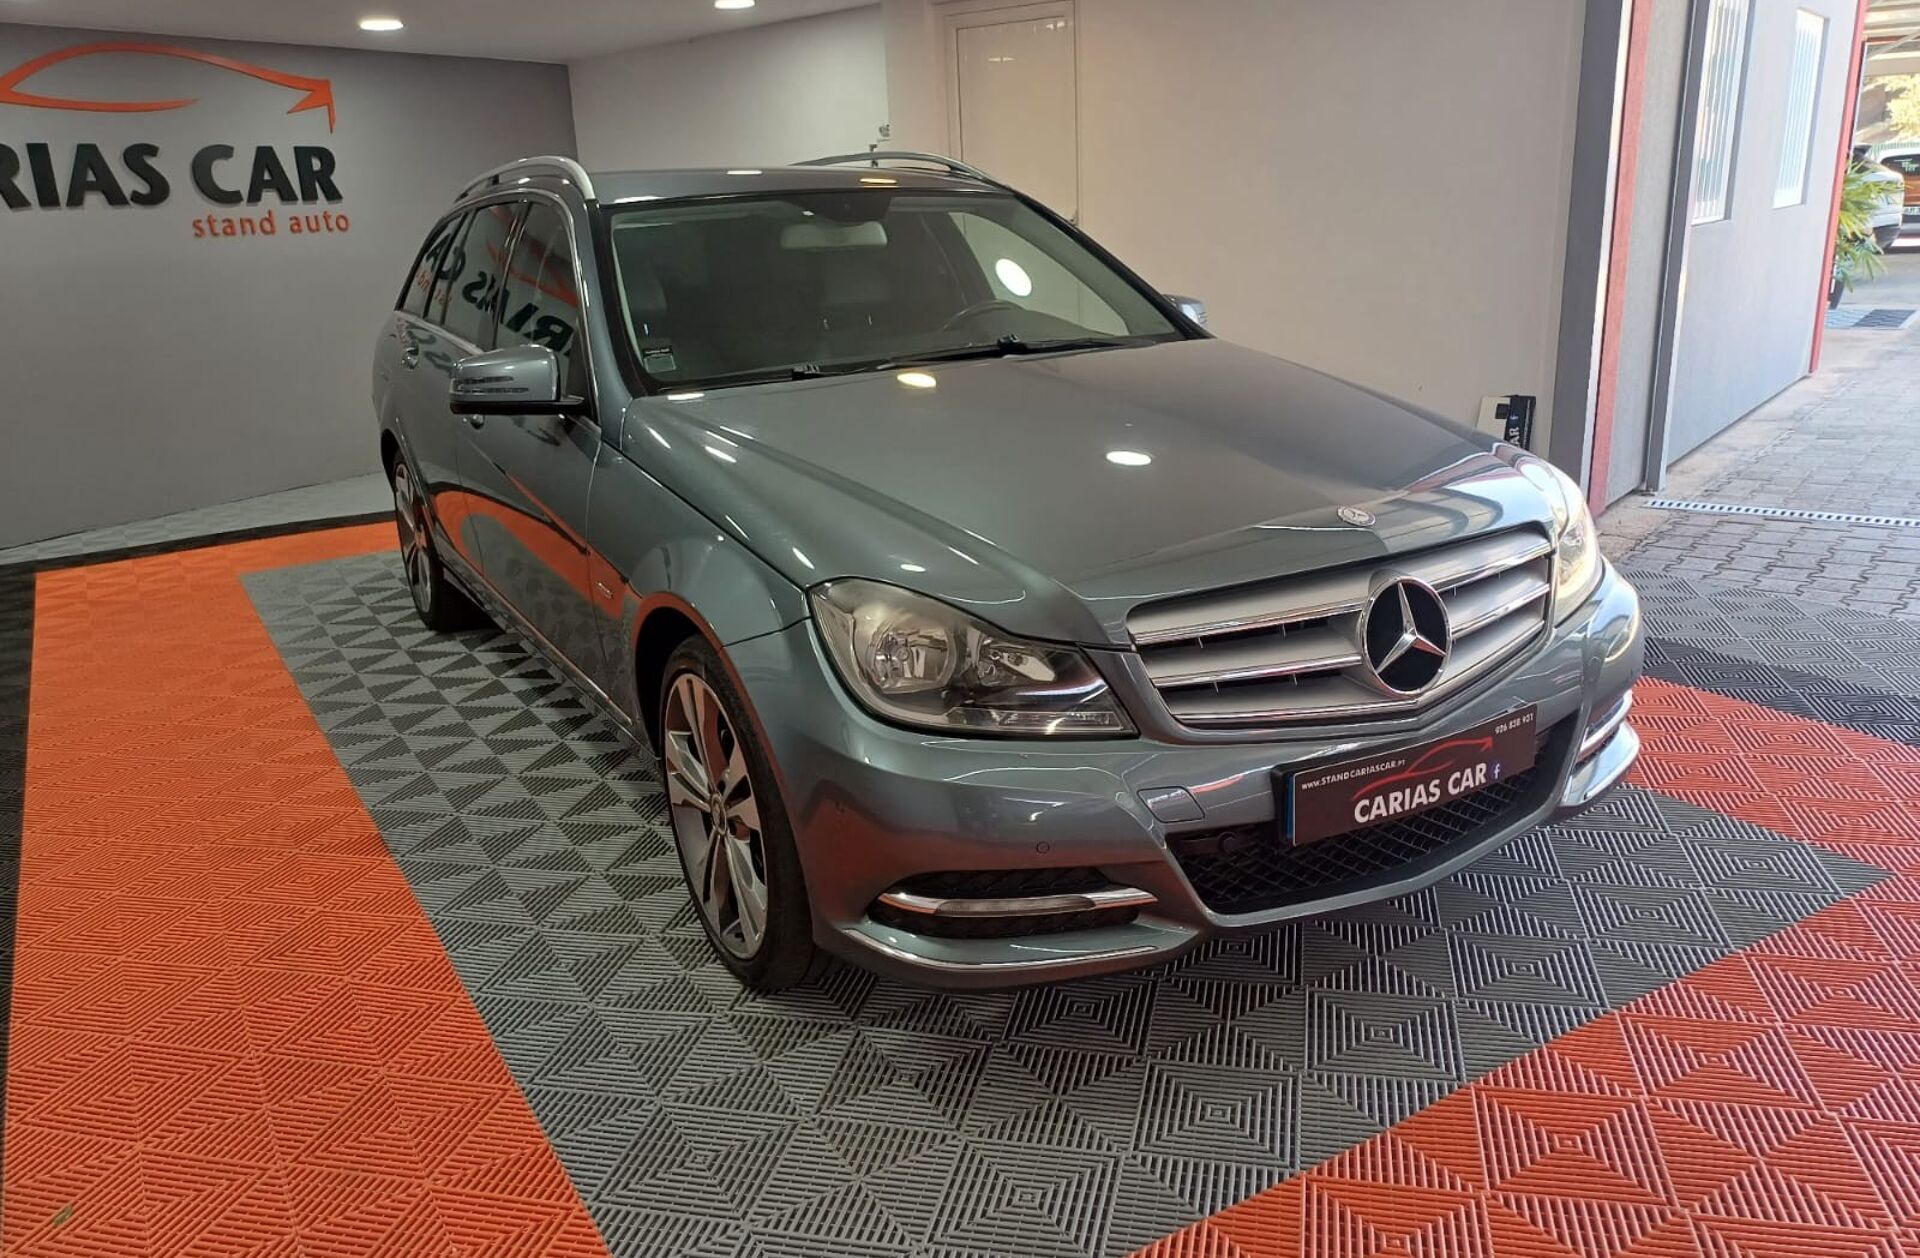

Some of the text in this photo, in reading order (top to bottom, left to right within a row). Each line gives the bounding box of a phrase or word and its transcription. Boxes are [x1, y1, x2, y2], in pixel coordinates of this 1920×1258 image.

[191, 143, 343, 205] CAR
[192, 209, 350, 238] stand auto
[1354, 779, 1440, 823] CARIAS
[1448, 763, 1487, 795] CAR
